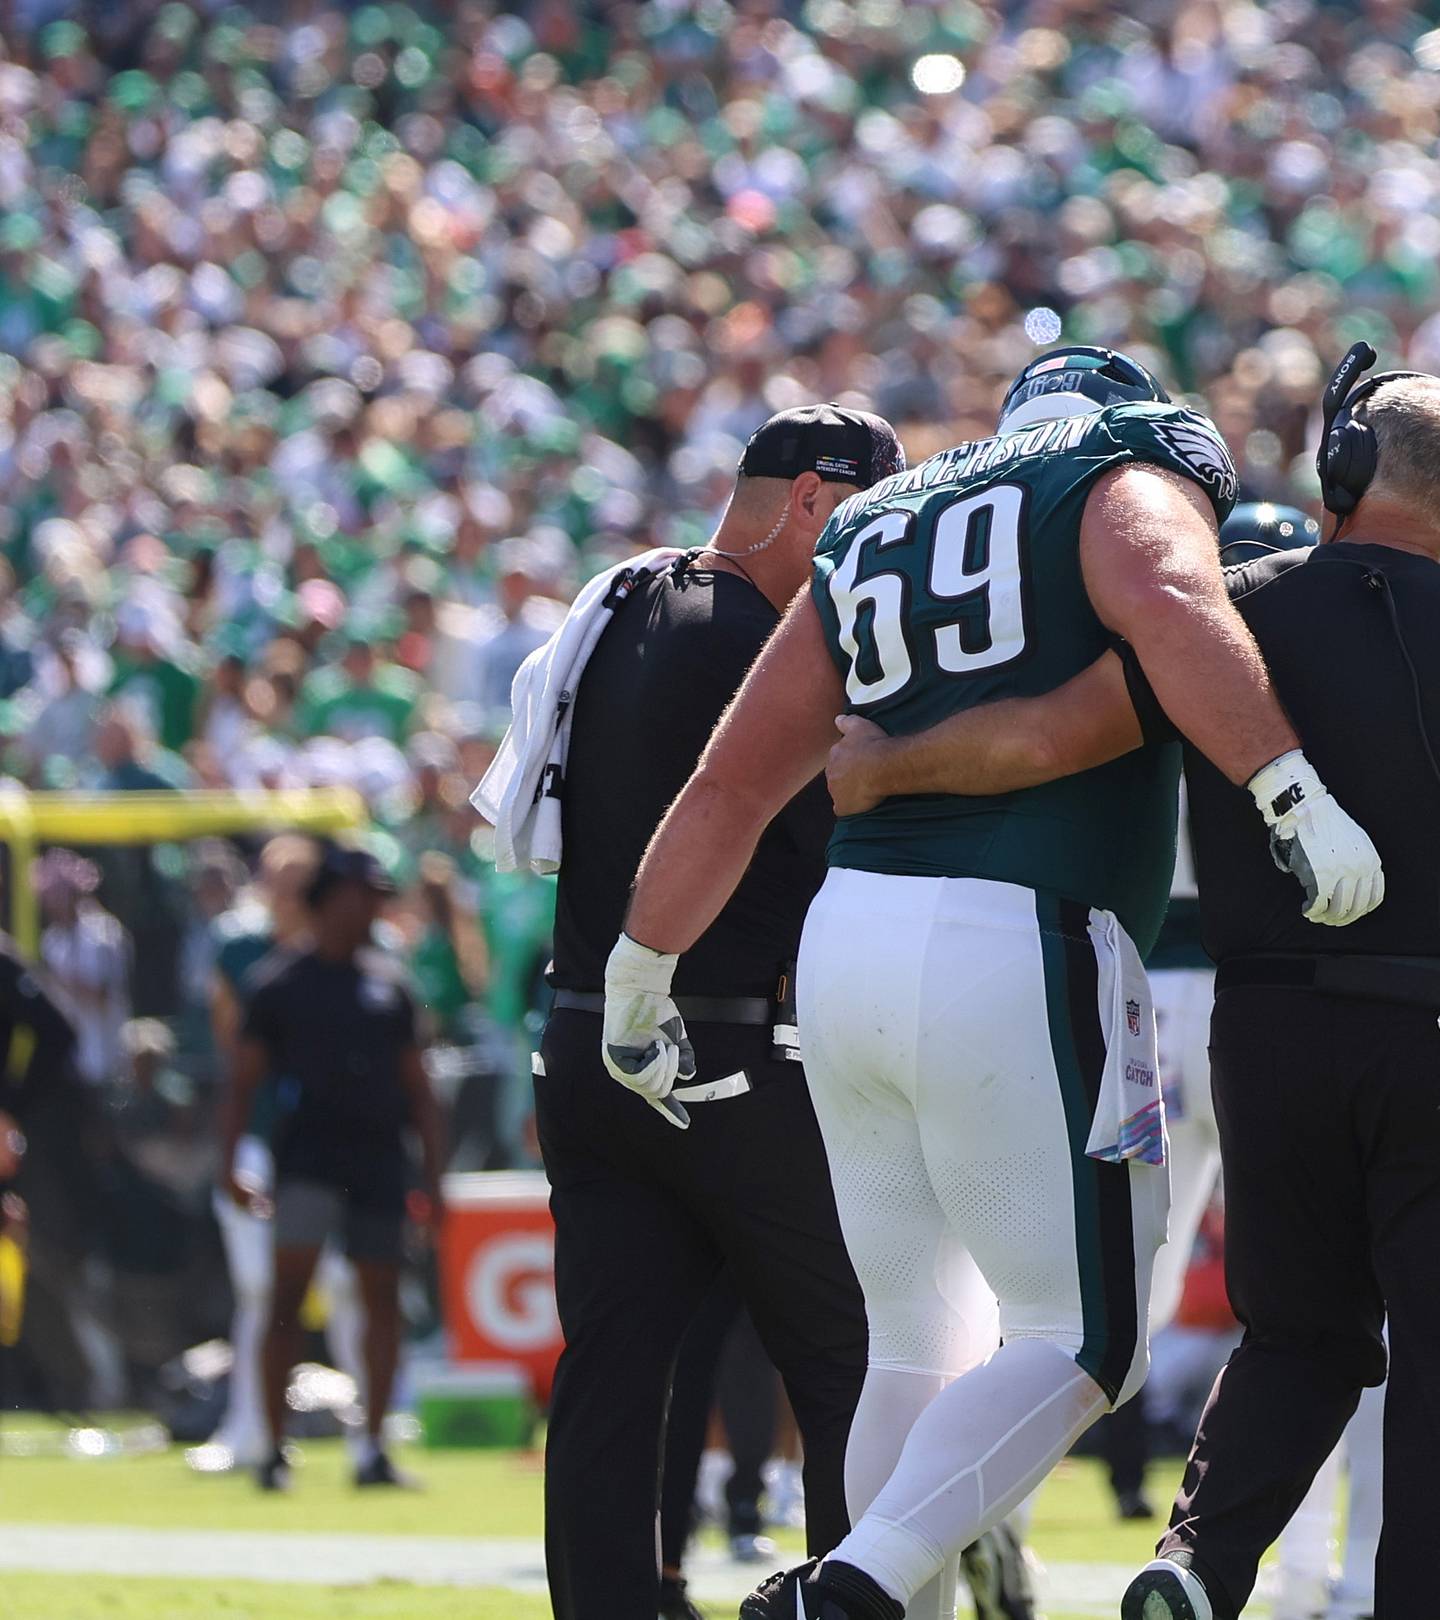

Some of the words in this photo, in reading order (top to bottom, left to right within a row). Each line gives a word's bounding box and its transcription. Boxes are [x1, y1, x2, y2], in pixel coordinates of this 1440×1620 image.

[1025, 371, 1085, 401] 69
[1330, 353, 1356, 395] SONY
[828, 484, 1027, 706] 69
[1125, 1064, 1153, 1087] CATCH
[464, 1230, 558, 1353] G
